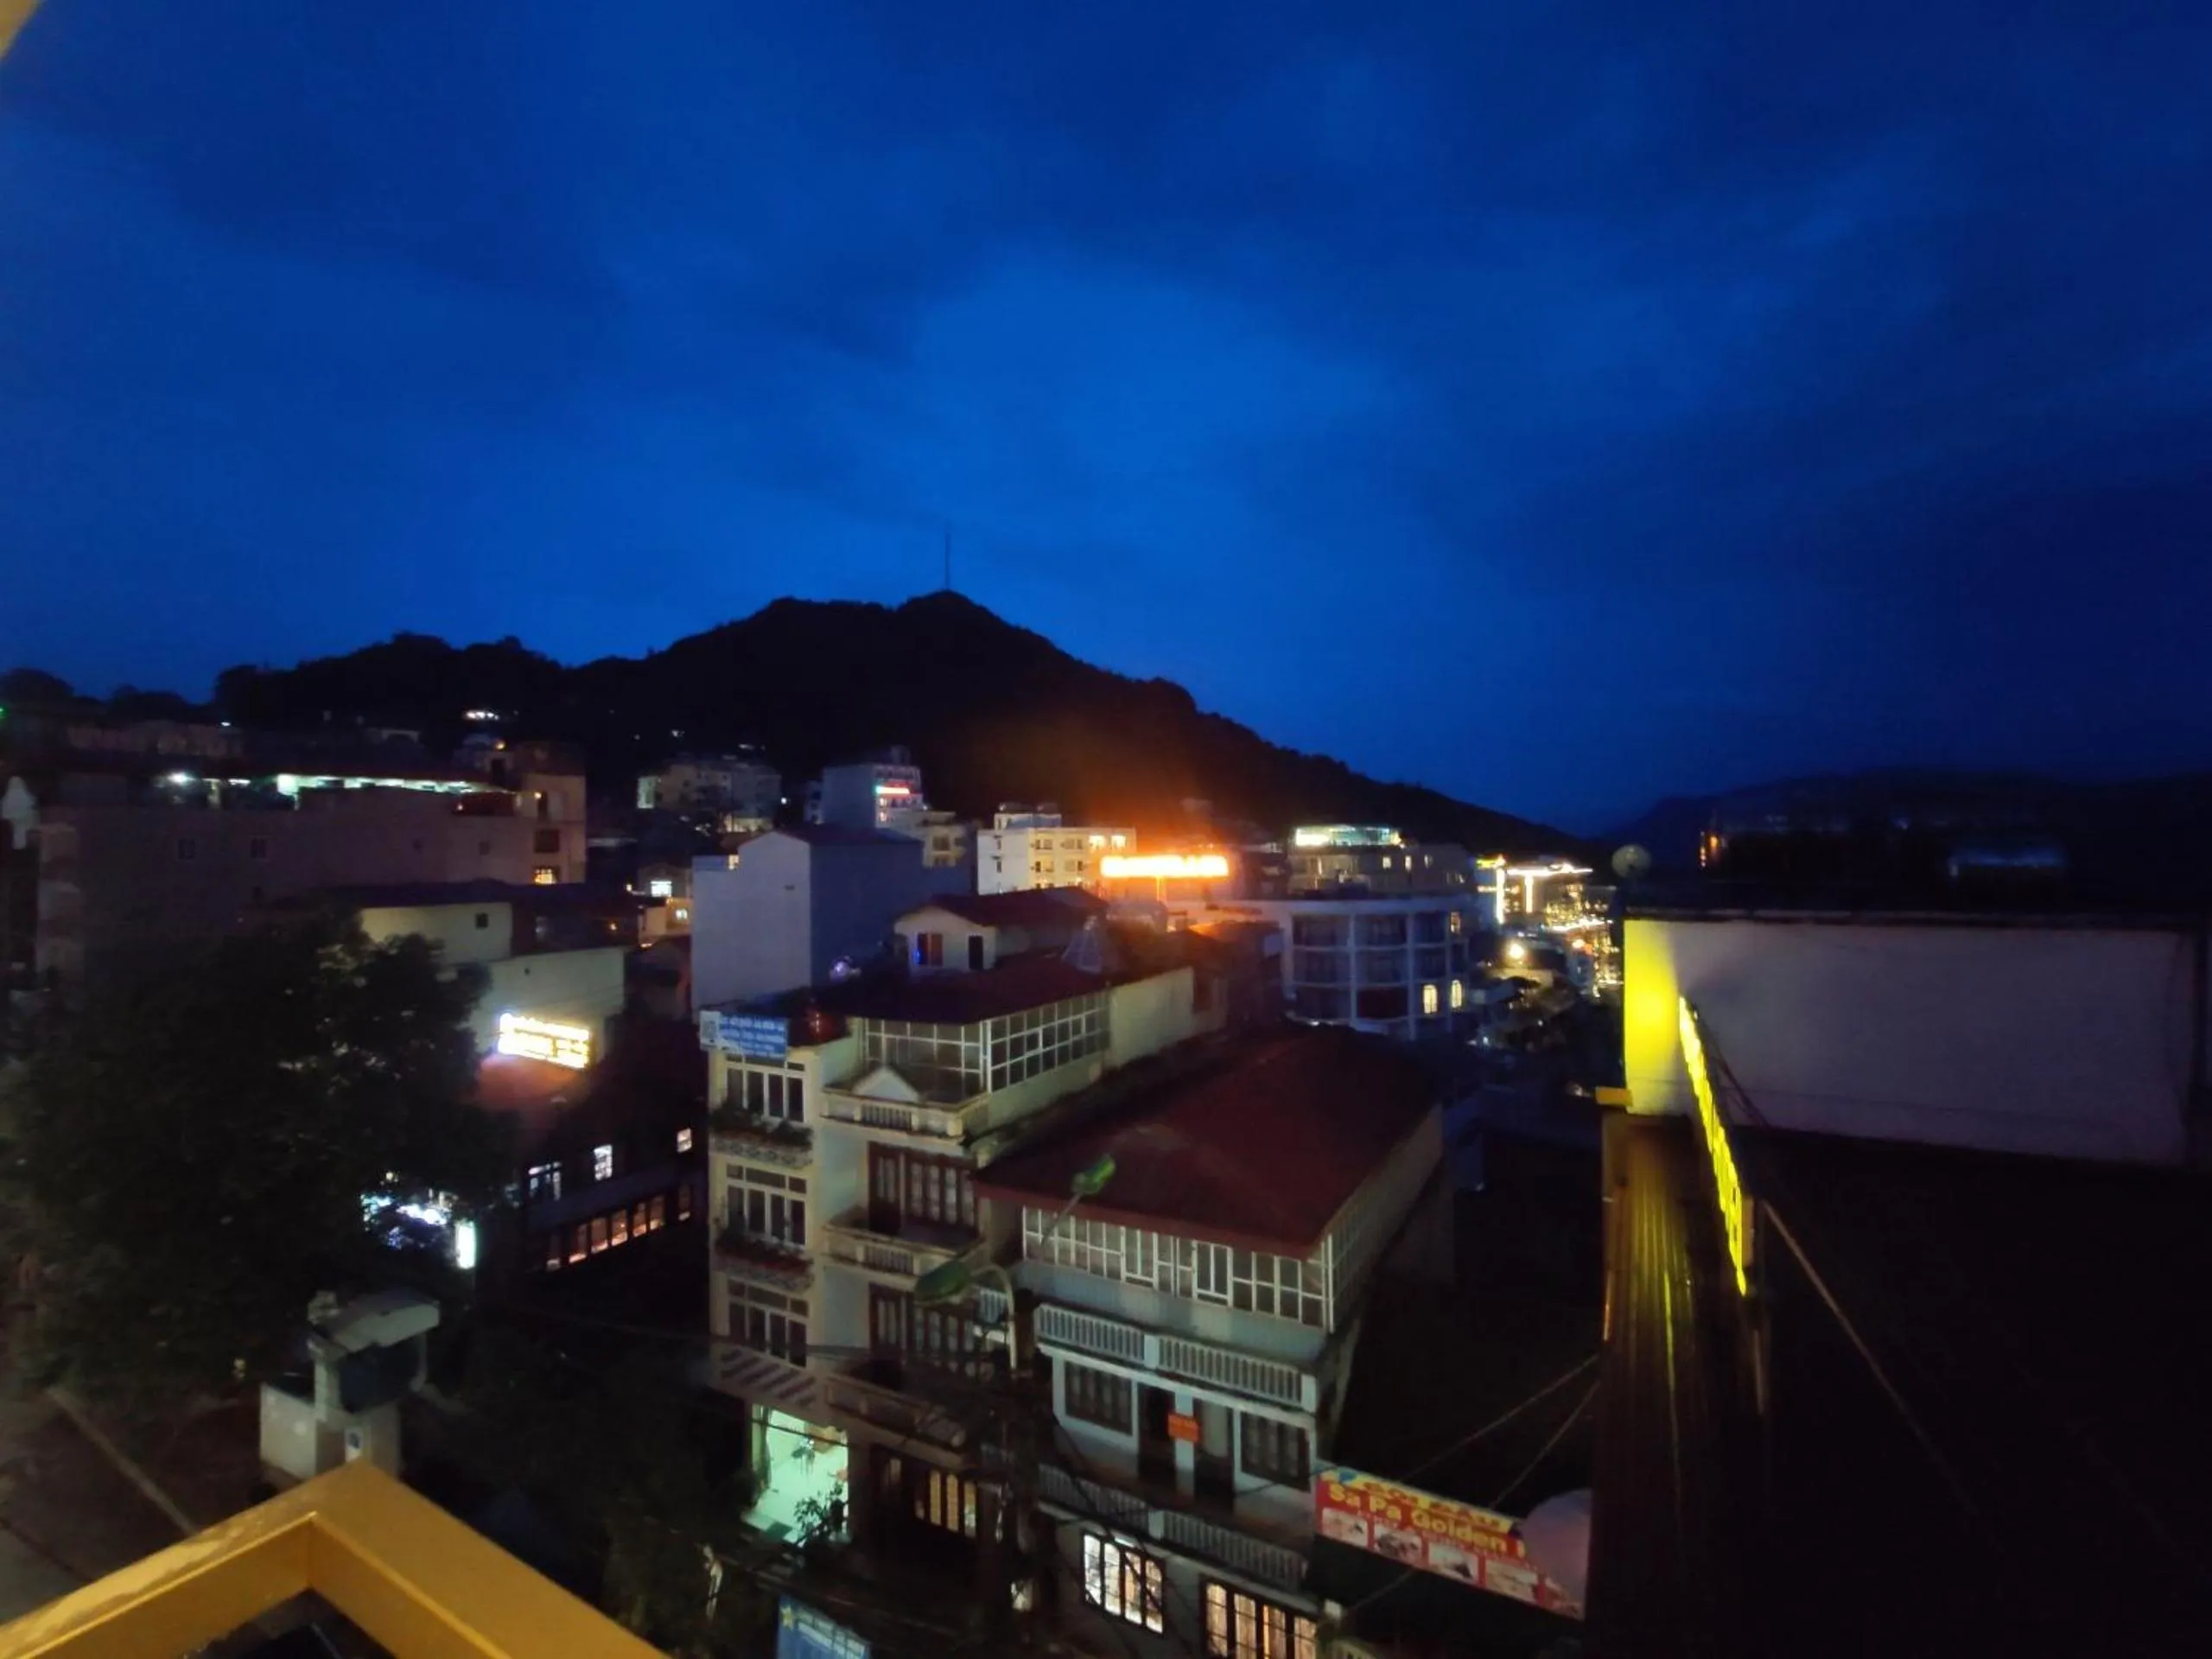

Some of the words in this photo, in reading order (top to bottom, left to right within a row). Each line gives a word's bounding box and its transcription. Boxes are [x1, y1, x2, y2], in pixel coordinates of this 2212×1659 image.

[1329, 1482, 1361, 1508] Sa
[1369, 1493, 1401, 1522] Pa
[1411, 1509, 1507, 1554] Golden
